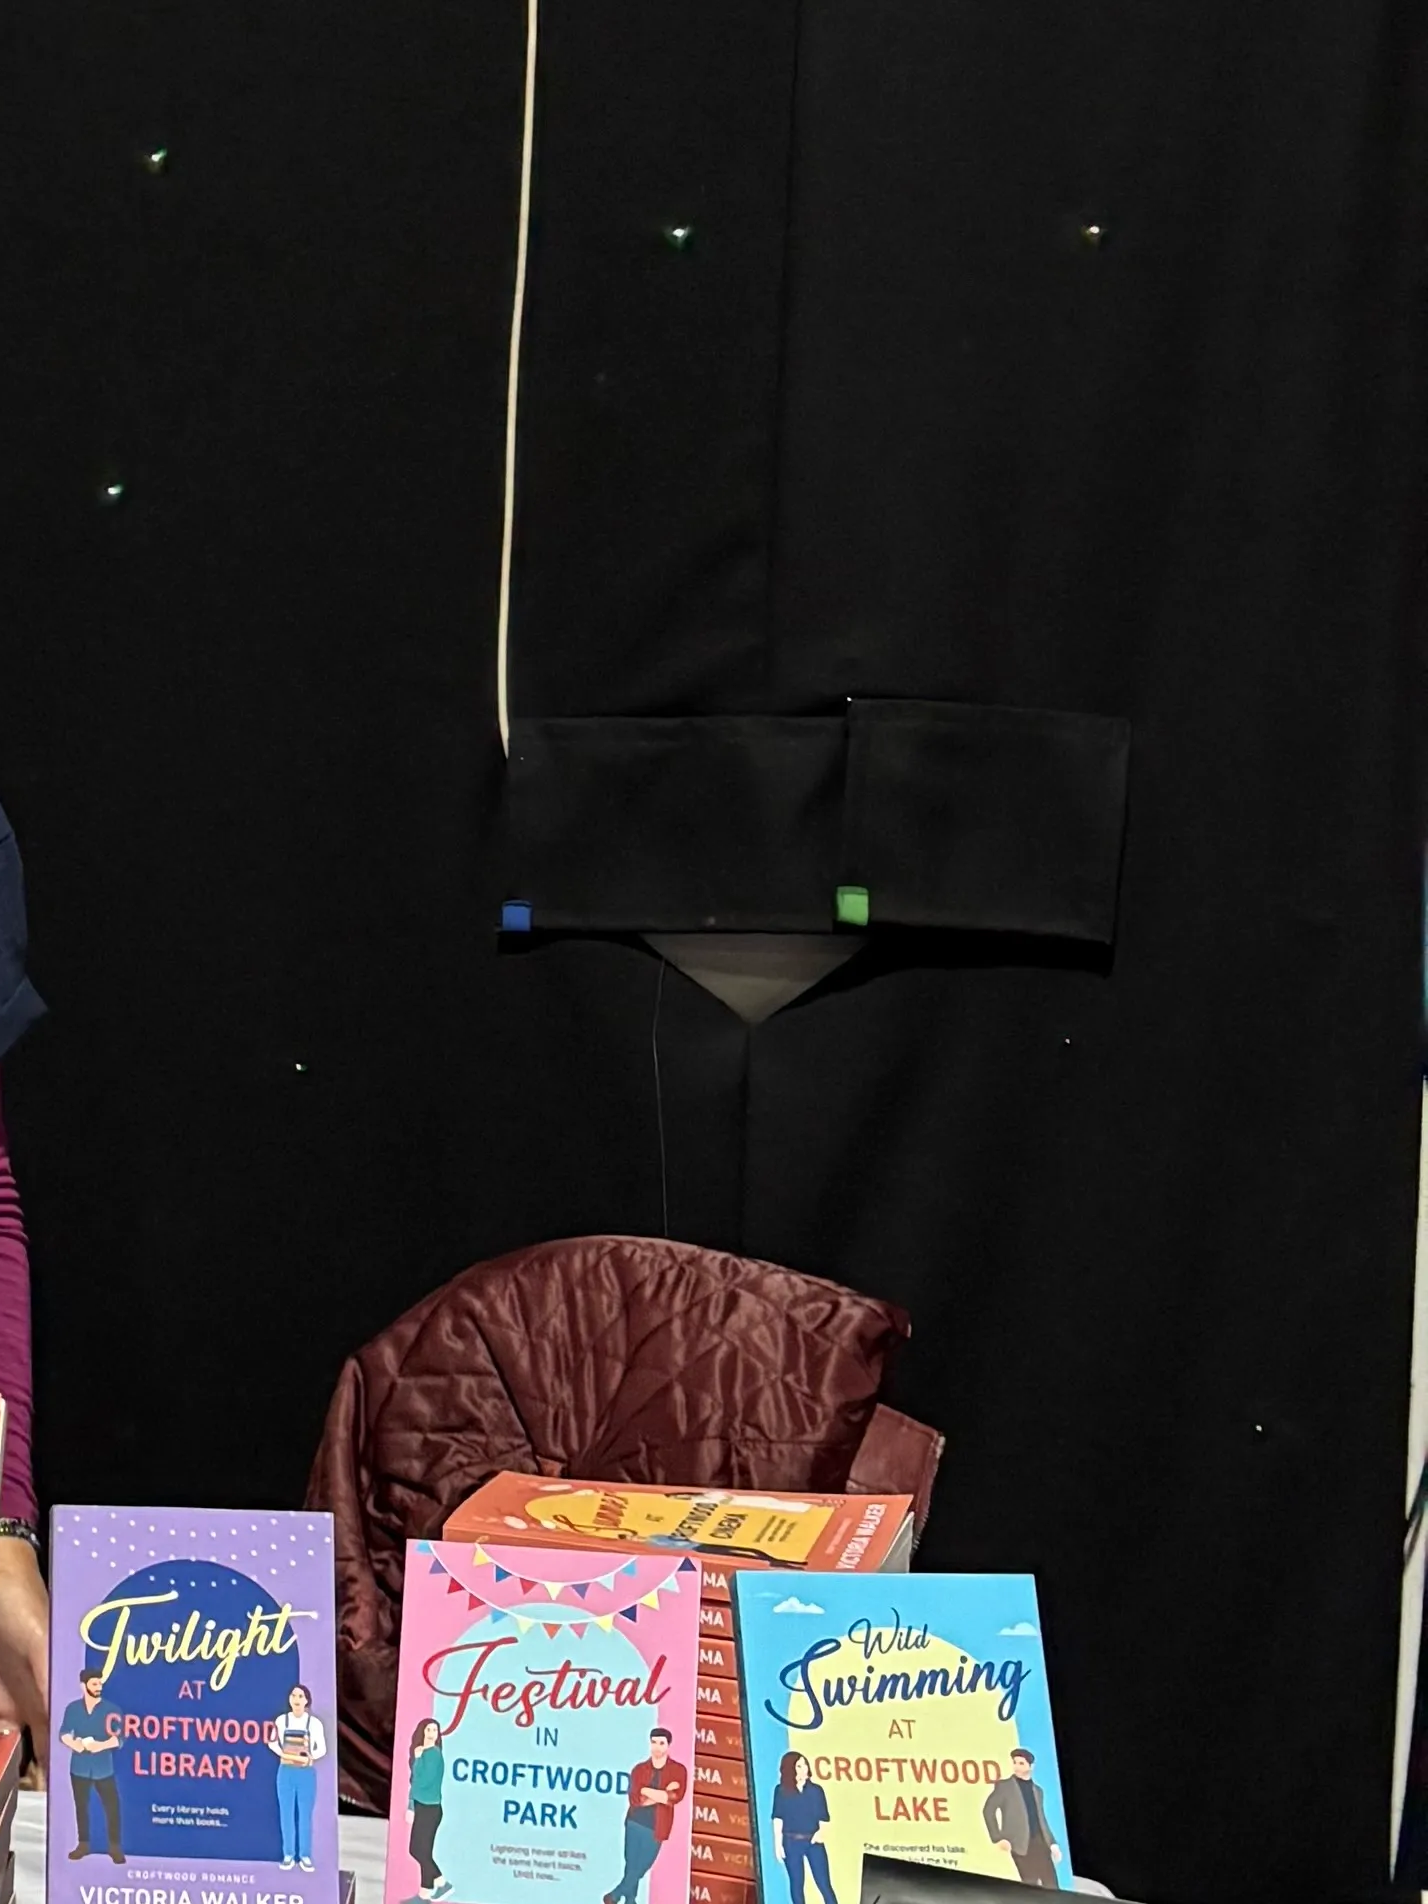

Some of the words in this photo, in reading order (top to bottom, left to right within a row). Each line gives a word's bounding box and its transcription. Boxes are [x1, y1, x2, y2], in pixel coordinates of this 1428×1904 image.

[80, 1590, 318, 1692] Twilight
[849, 1606, 931, 1654] Wild
[178, 1678, 205, 1701] AT
[423, 1636, 671, 1734] Festival
[765, 1638, 1032, 1731] Swimming
[105, 1712, 280, 1744] CROFTWOOD
[535, 1726, 559, 1747] IN
[888, 1718, 917, 1739] AT
[133, 1752, 252, 1780] LIBRARY
[451, 1757, 632, 1796] CROFTWOOD
[814, 1757, 1001, 1786] CROFTWOOD
[502, 1801, 579, 1830] PARK
[873, 1794, 951, 1823] LAKE
